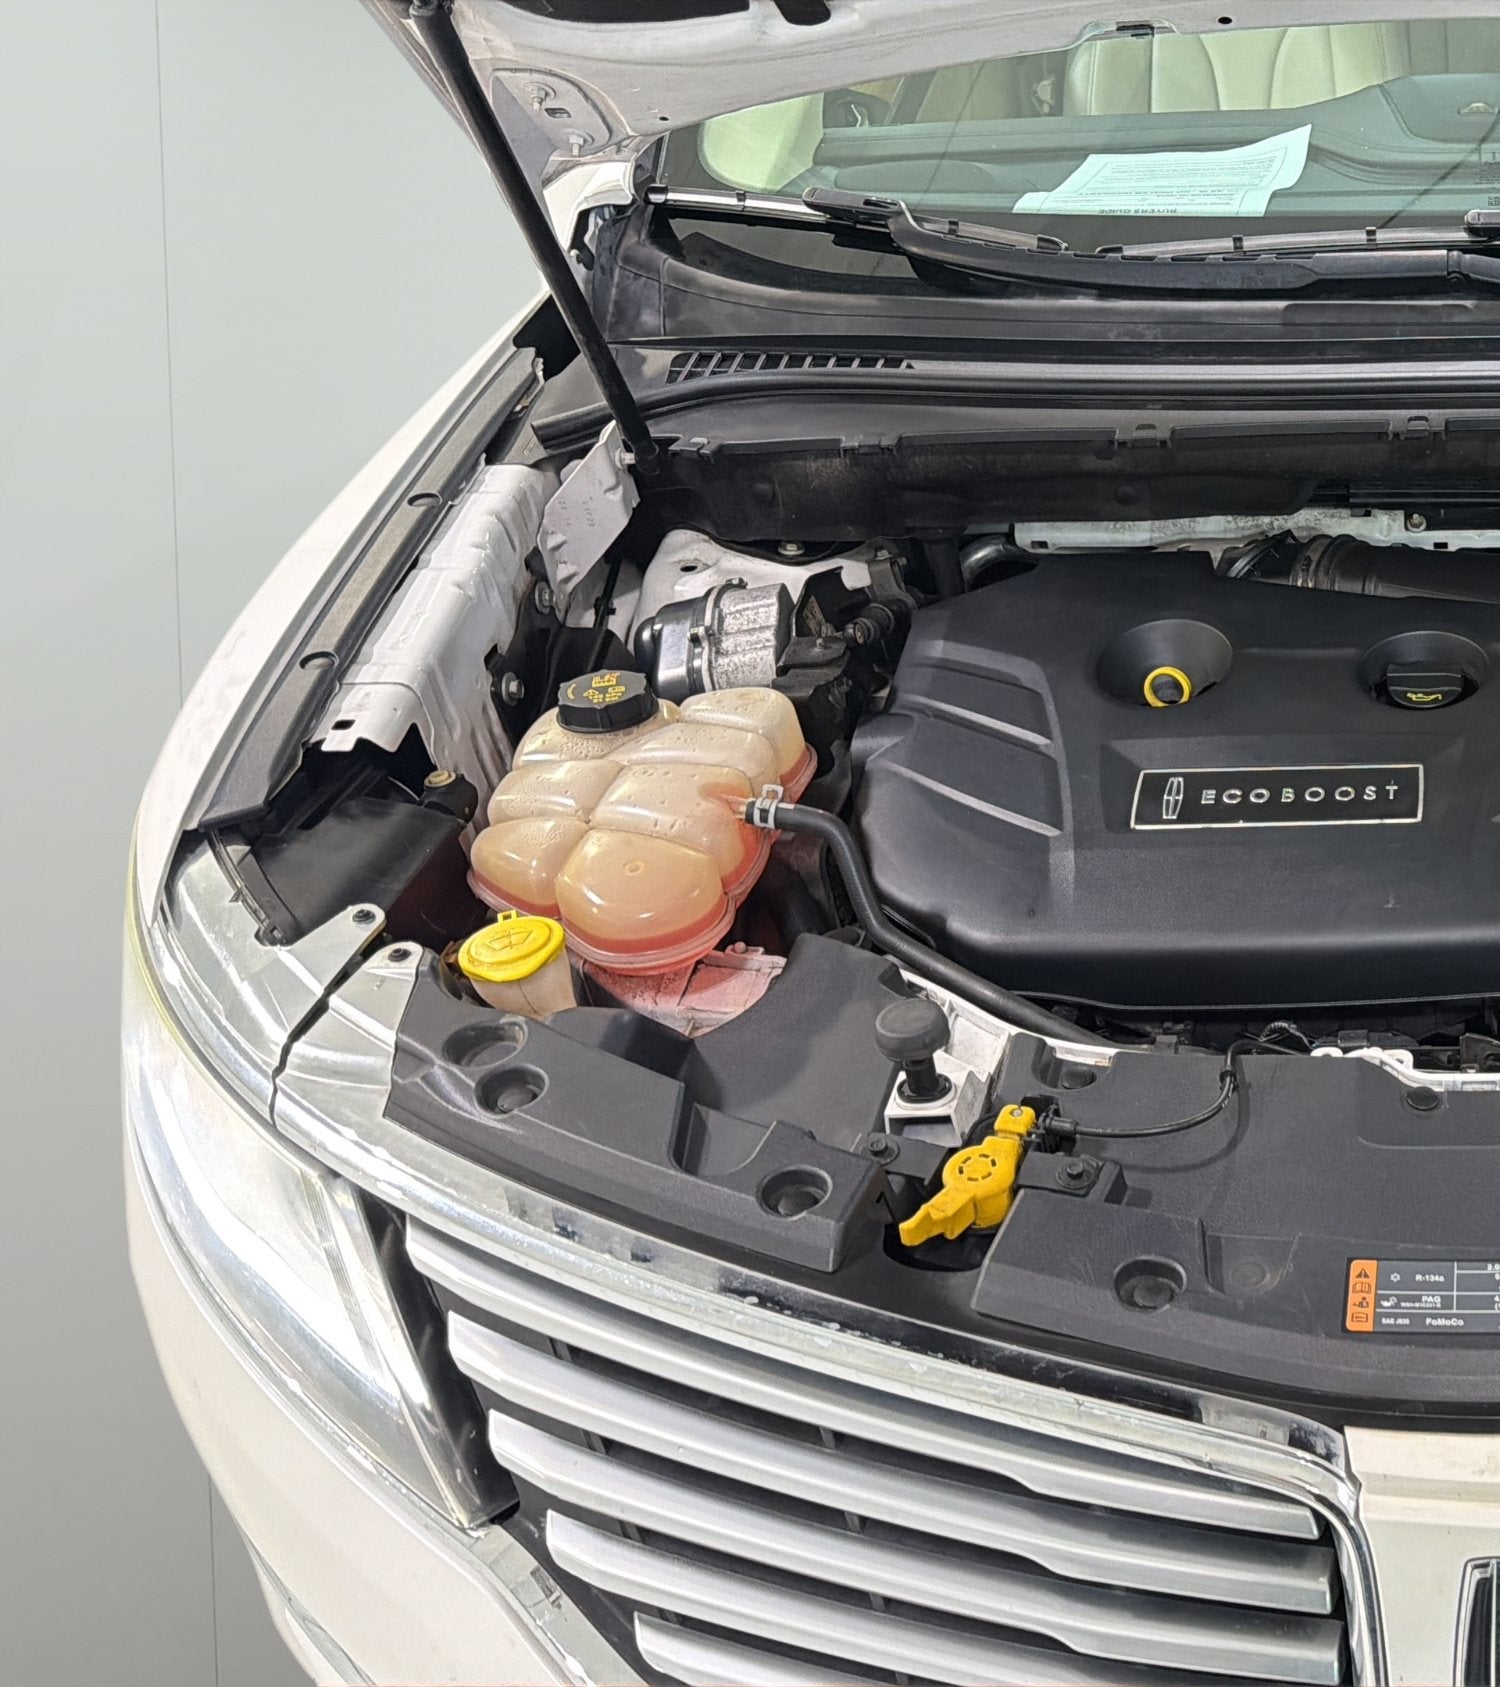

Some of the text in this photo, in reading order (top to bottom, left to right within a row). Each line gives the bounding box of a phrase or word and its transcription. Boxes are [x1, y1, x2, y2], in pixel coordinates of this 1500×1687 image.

[1201, 785, 1399, 805] ECOBOOST
[1415, 1274, 1444, 1282] R-134a
[1421, 1295, 1441, 1303] PAG
[1425, 1317, 1464, 1326] FoMoCo
